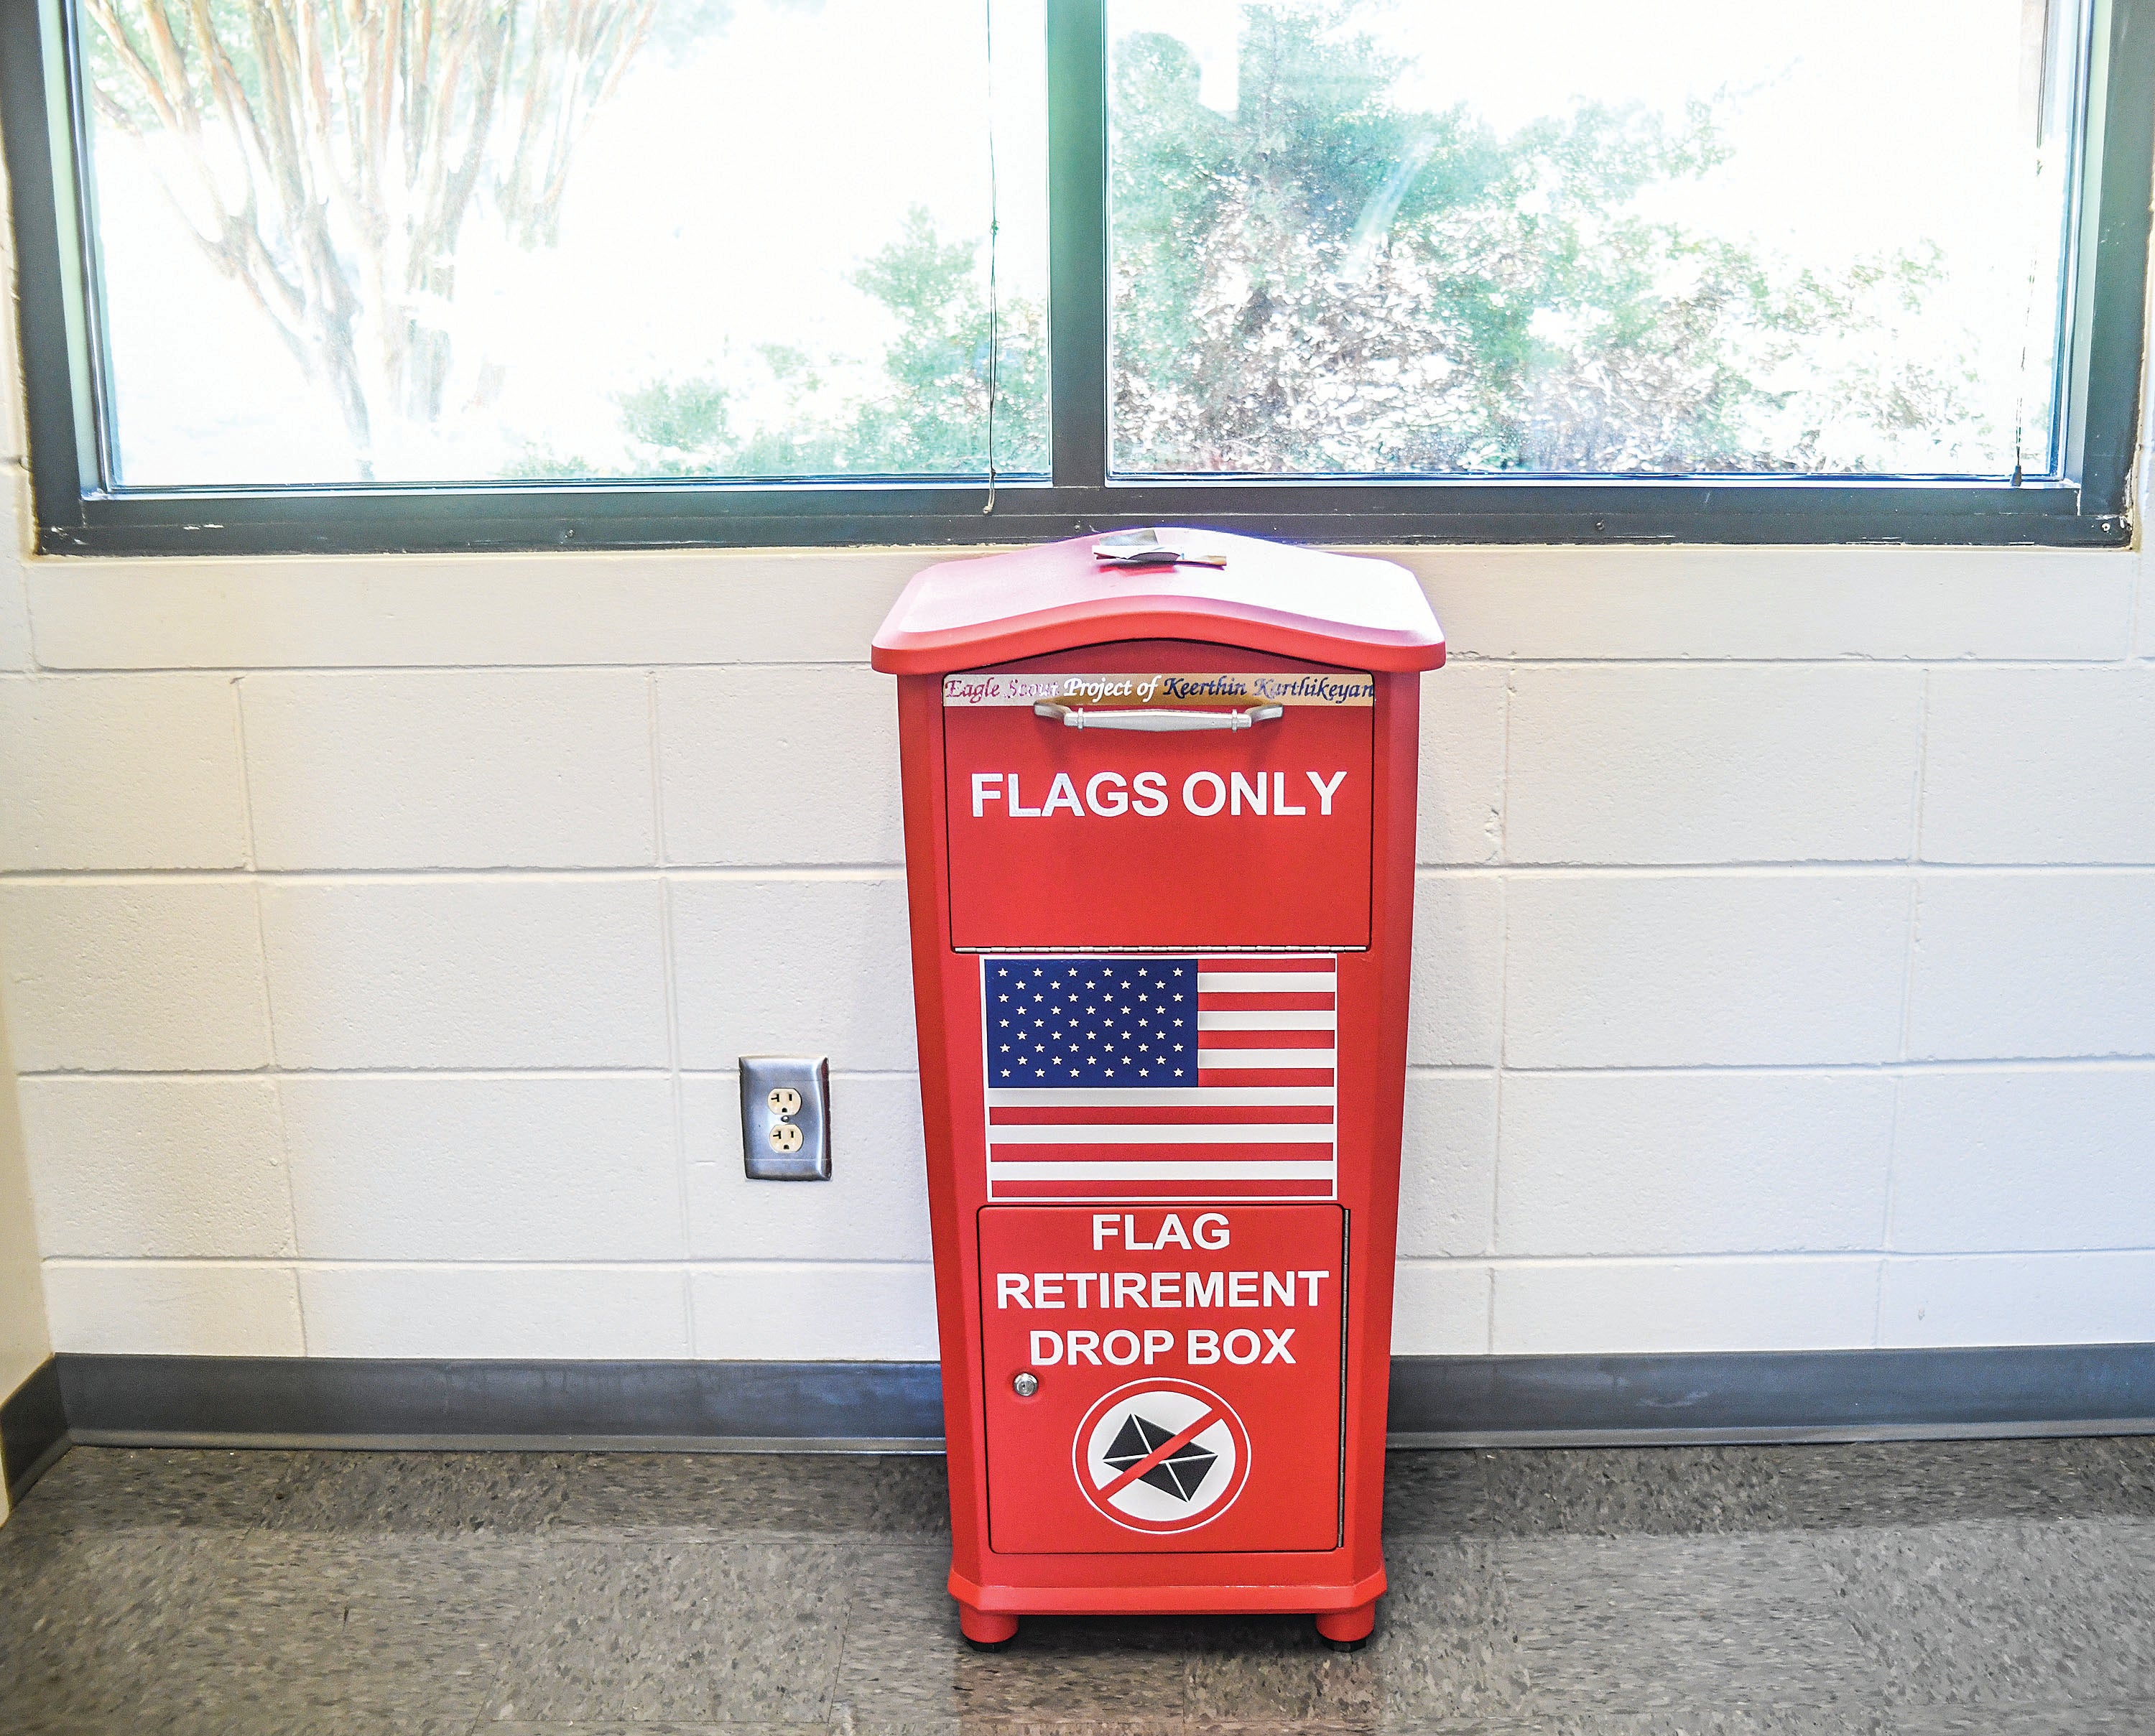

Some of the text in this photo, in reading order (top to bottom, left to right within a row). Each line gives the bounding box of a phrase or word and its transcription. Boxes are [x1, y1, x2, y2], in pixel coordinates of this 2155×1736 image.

[945, 677, 1001, 703] Eagle
[1004, 678, 1059, 698] Scout
[1064, 677, 1132, 702] Project
[1136, 675, 1162, 702] of
[1163, 675, 1247, 699] Keerthin
[971, 771, 1347, 817] FLAGS ONLY
[1093, 1213, 1231, 1250] FLAG
[997, 1271, 1329, 1309] RETIREMENT
[1030, 1329, 1296, 1365] DROP BOX
